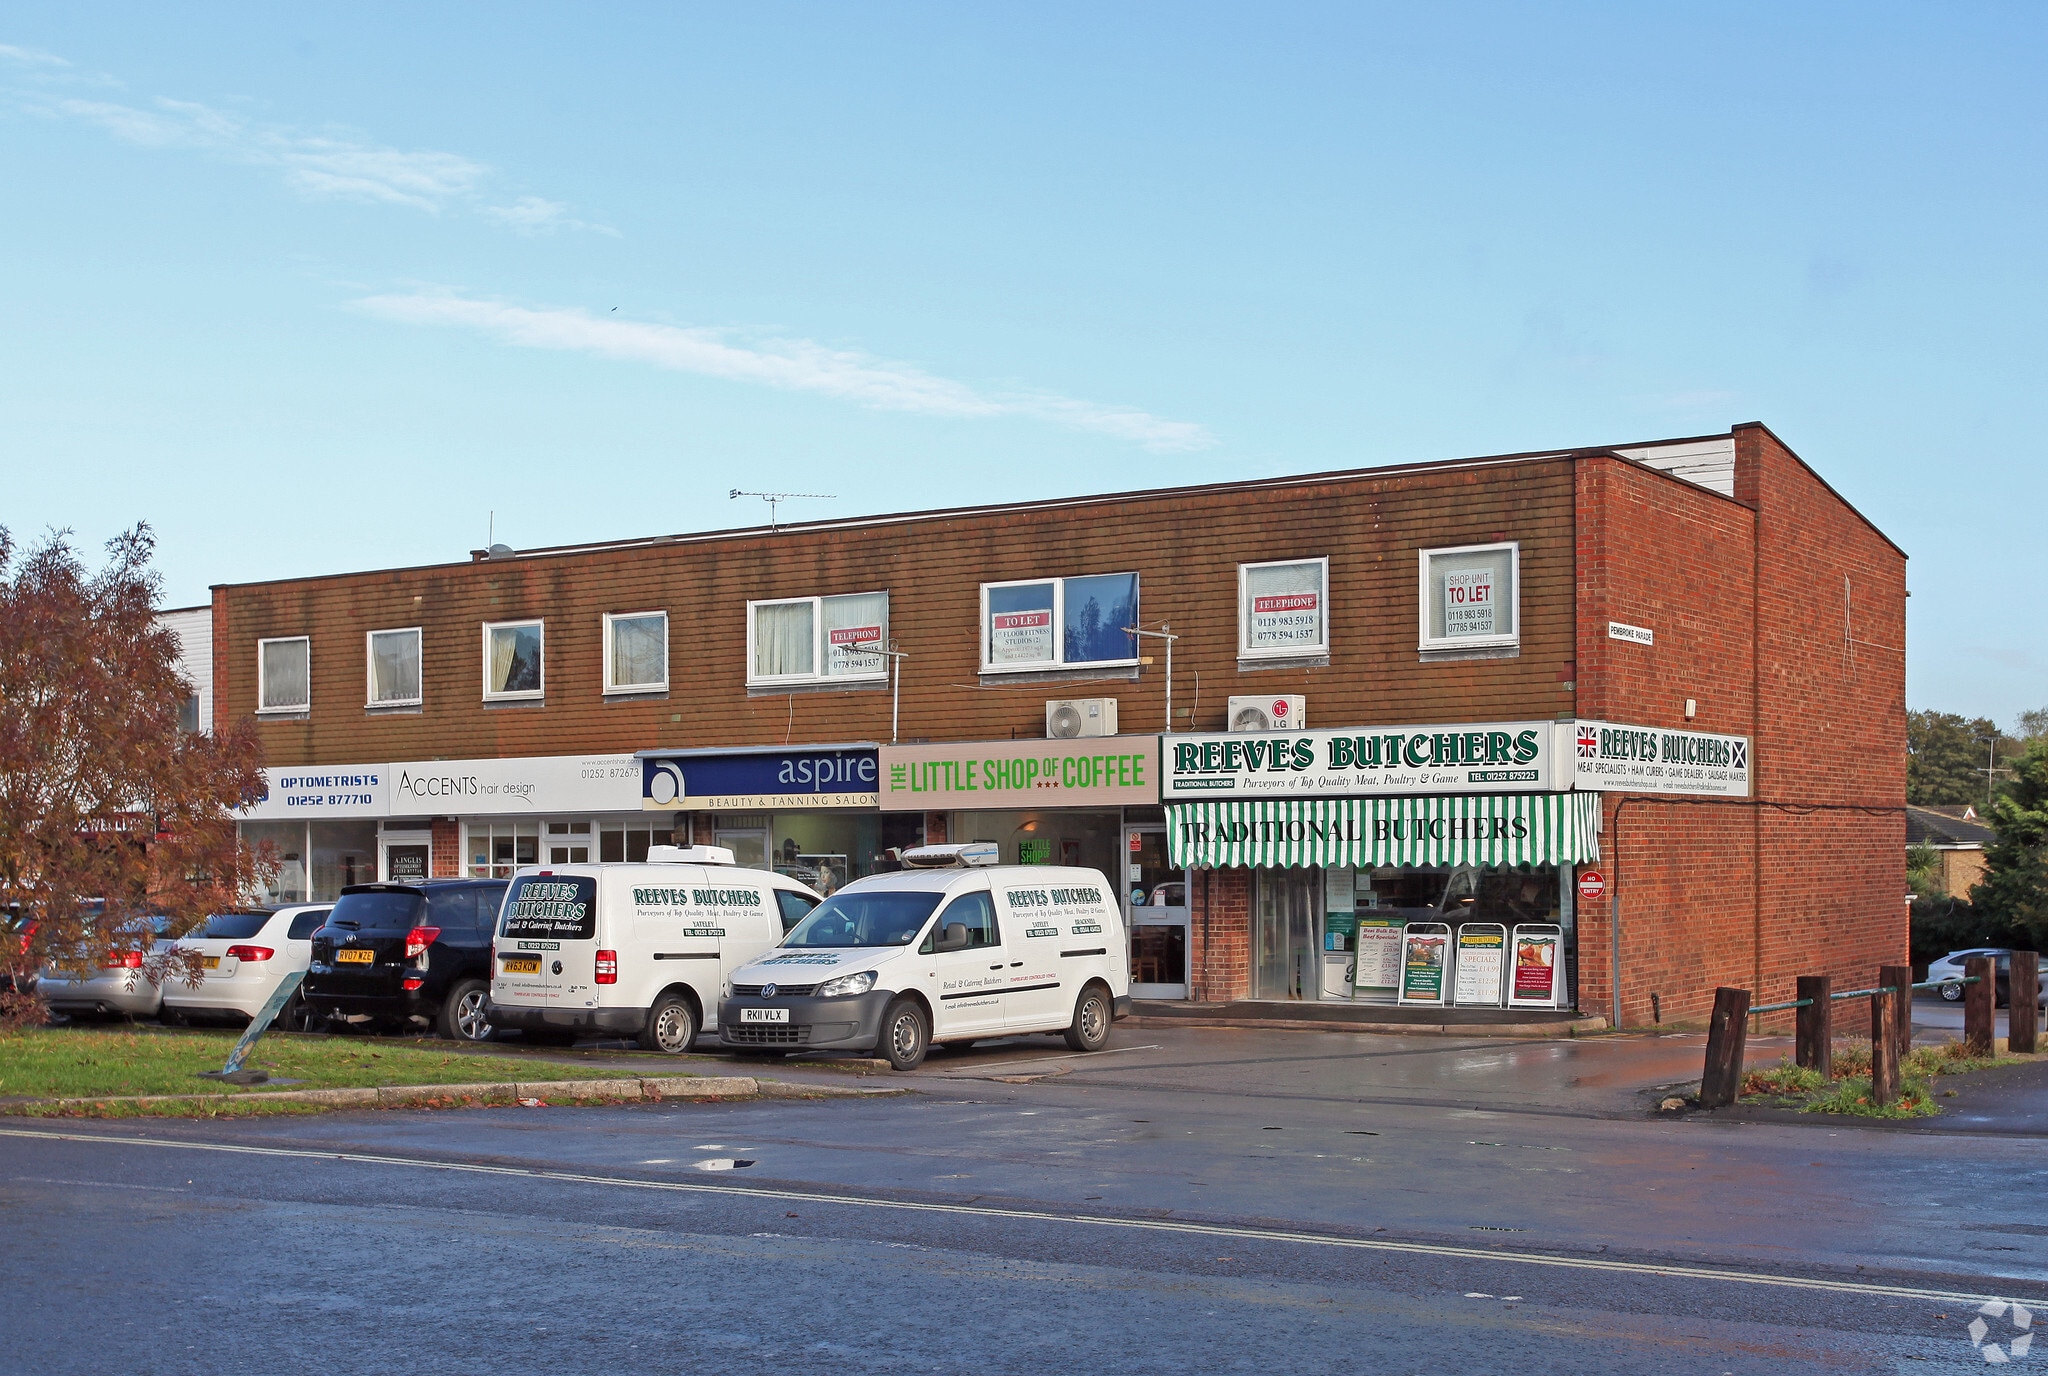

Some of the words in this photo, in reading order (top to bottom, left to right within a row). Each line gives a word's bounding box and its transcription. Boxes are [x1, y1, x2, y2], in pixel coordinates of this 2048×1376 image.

[1449, 574, 1469, 586] SHOP
[1472, 573, 1489, 584] UNIT
[1449, 586, 1465, 604] TO
[1468, 585, 1490, 602] LET
[1259, 598, 1313, 608] TELEPHONE
[1005, 617, 1018, 626] TO
[1020, 616, 1040, 625] LET
[1258, 618, 1276, 627] 0118
[1279, 616, 1293, 626] 983
[1295, 615, 1313, 625] 5918
[1448, 610, 1463, 621] 0118
[1464, 610, 1476, 620] 983
[1476, 608, 1492, 620] 5918
[1469, 620, 1492, 631] 941537
[834, 630, 878, 640] TELEPHONE
[1258, 632, 1276, 641] 0778
[1279, 631, 1293, 640] 594
[1296, 630, 1313, 638] 1537
[1610, 626, 1634, 638] PEMBROKE
[1636, 630, 1651, 641] PARADE
[834, 660, 849, 669] 0778
[1274, 720, 1287, 728] LG
[1173, 737, 1315, 774] REEVES
[1328, 730, 1540, 770] BUTCHERS
[1600, 728, 1658, 762] REEVES
[1661, 734, 1730, 768] BUTCHERS
[582, 768, 605, 779] 01252
[610, 768, 640, 778] 872673
[778, 751, 877, 792] aspire
[891, 763, 906, 792] THE
[911, 760, 978, 792] LITTLE
[983, 758, 1039, 790] SHOP
[1043, 758, 1059, 777] OF
[1062, 754, 1145, 788] COFFEE
[1471, 772, 1484, 782] TEL:
[1486, 772, 1508, 781] 01252
[1510, 771, 1535, 781] 875225
[1577, 762, 1593, 773] MEAT
[1595, 763, 1626, 775] SPECIALISTS
[1632, 765, 1644, 775] HAM
[1646, 766, 1664, 777] CURERS
[1669, 767, 1682, 778] GAME
[1684, 768, 1703, 779] DEALERS
[1708, 770, 1728, 780] SAUSAGE
[1729, 771, 1746, 782] MAKERS
[280, 774, 378, 789] OPTOMETRISTS
[1243, 777, 1286, 790] Purveyors
[1288, 776, 1298, 788] of
[1300, 776, 1314, 790] Top
[1318, 774, 1351, 788] Quality
[1354, 774, 1379, 786] Meat,
[1384, 773, 1416, 786] Poultry
[1420, 772, 1430, 784] &
[1432, 773, 1458, 784] Game
[480, 783, 500, 795] hair
[502, 781, 536, 796] design
[287, 796, 323, 806] 01252
[328, 794, 372, 806] 877710
[709, 798, 753, 807] BEAUTY
[759, 797, 766, 806] &
[772, 796, 828, 806] TANNING
[836, 795, 878, 804] SALON
[1180, 818, 1362, 844] TRADITIONAL
[1374, 816, 1528, 842] BUTCHERS
[1028, 839, 1050, 850] LITTLE
[1021, 850, 1042, 863] SHOP
[518, 883, 579, 901] REEVES
[633, 888, 688, 905] REEVES
[692, 889, 761, 907] BUTCHERS
[1007, 890, 1048, 908] REEVES
[1050, 888, 1102, 905] BUTCHERS
[507, 901, 586, 921] BUTCHERS
[506, 921, 520, 930] Retail
[528, 920, 553, 930] Catering
[554, 921, 582, 931] Butchers
[943, 981, 956, 990] Retail
[984, 977, 1002, 985] Butchers
[764, 1010, 781, 1020] VLX
